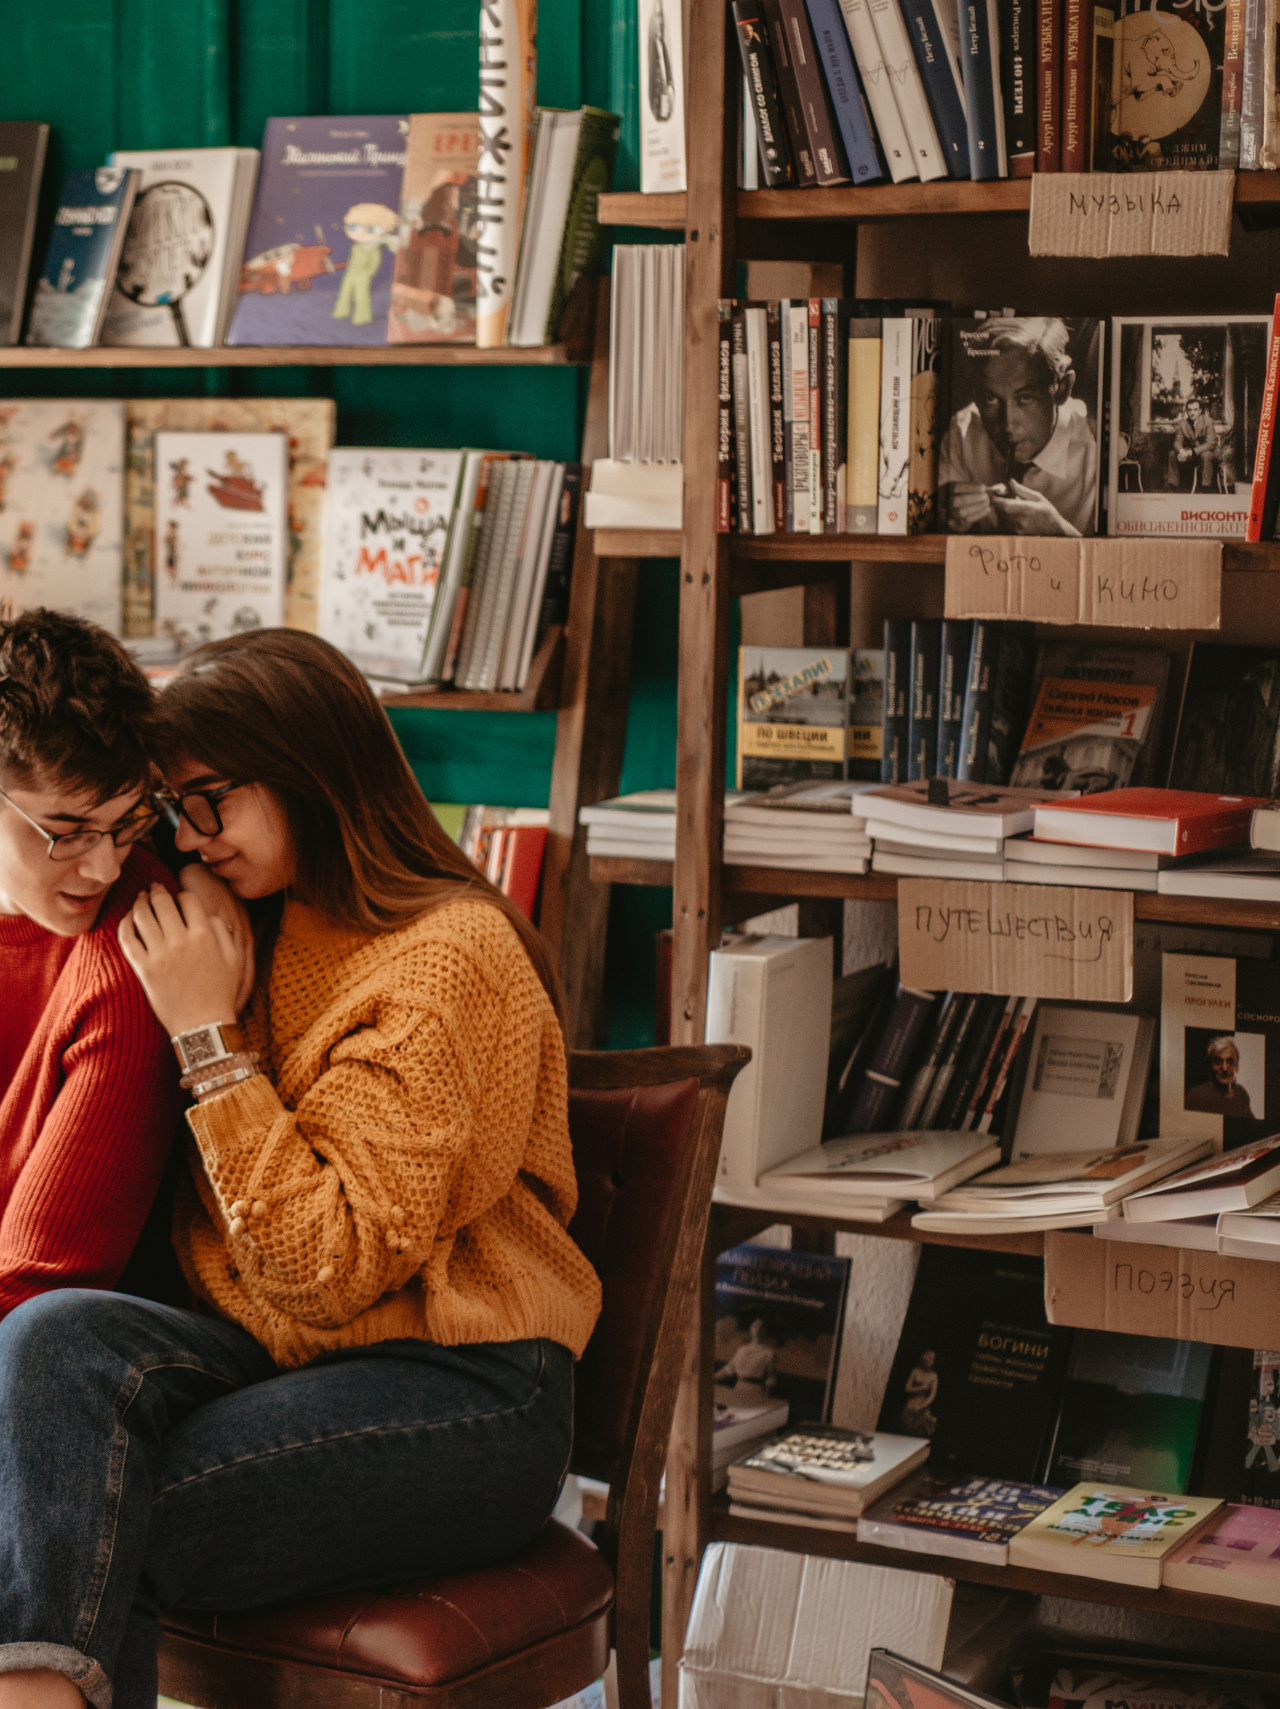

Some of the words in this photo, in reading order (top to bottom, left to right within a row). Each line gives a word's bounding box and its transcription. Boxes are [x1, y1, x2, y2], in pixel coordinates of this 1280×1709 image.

[916, 16, 931, 42] Белый
[966, 5, 978, 33] Белый
[969, 33, 980, 55] Петр
[1041, 19, 1053, 63] МУЗЫКА
[1067, 15, 1080, 62] МУЗЫКА
[1227, 8, 1242, 61] Венеция
[922, 41, 935, 63] Петр
[755, 92, 767, 107] СО
[1042, 70, 1054, 122] Штильман
[1066, 68, 1078, 121] Штильман
[758, 107, 774, 143] ДИАЛОГ
[1227, 99, 1238, 127] Патрик
[1042, 123, 1054, 153] Артур
[1066, 122, 1078, 152] Артур
[1247, 132, 1255, 161] GARAGE
[1070, 186, 1182, 216] МУЗЫКА
[718, 339, 731, 403] фильмов
[771, 340, 783, 403] фильмов
[1264, 335, 1280, 393] Казовским
[891, 375, 901, 397] СЛОН
[1262, 392, 1275, 422] Элом
[718, 408, 731, 463] Теория
[772, 408, 784, 463] Теория
[891, 398, 901, 451] ИСЧЕЗАЮЩИЙ
[794, 432, 810, 493] РАЗГОВОРЫ
[1254, 429, 1270, 483] Разговоры
[1116, 520, 1213, 534] ОБНАЖЕННАЯ
[1216, 521, 1247, 534] ЖИЗ
[354, 546, 440, 587] МАГИ
[969, 544, 1041, 576] Фото
[1050, 579, 1062, 592] и
[1048, 687, 1096, 703] Сергей
[1097, 692, 1140, 707] Носов
[757, 726, 774, 740] ПО
[776, 728, 829, 743] ШВЕЦИИ
[1121, 712, 1137, 737] 1
[915, 905, 1114, 962] ПУТЕШЕСТВИЯ
[1184, 996, 1232, 1009] ПРОГУЛКИ
[1237, 1011, 1280, 1023] СОСНОРО
[978, 1332, 1050, 1359] БОГИНИ
[1080, 1495, 1197, 1519] ТЕЛО
